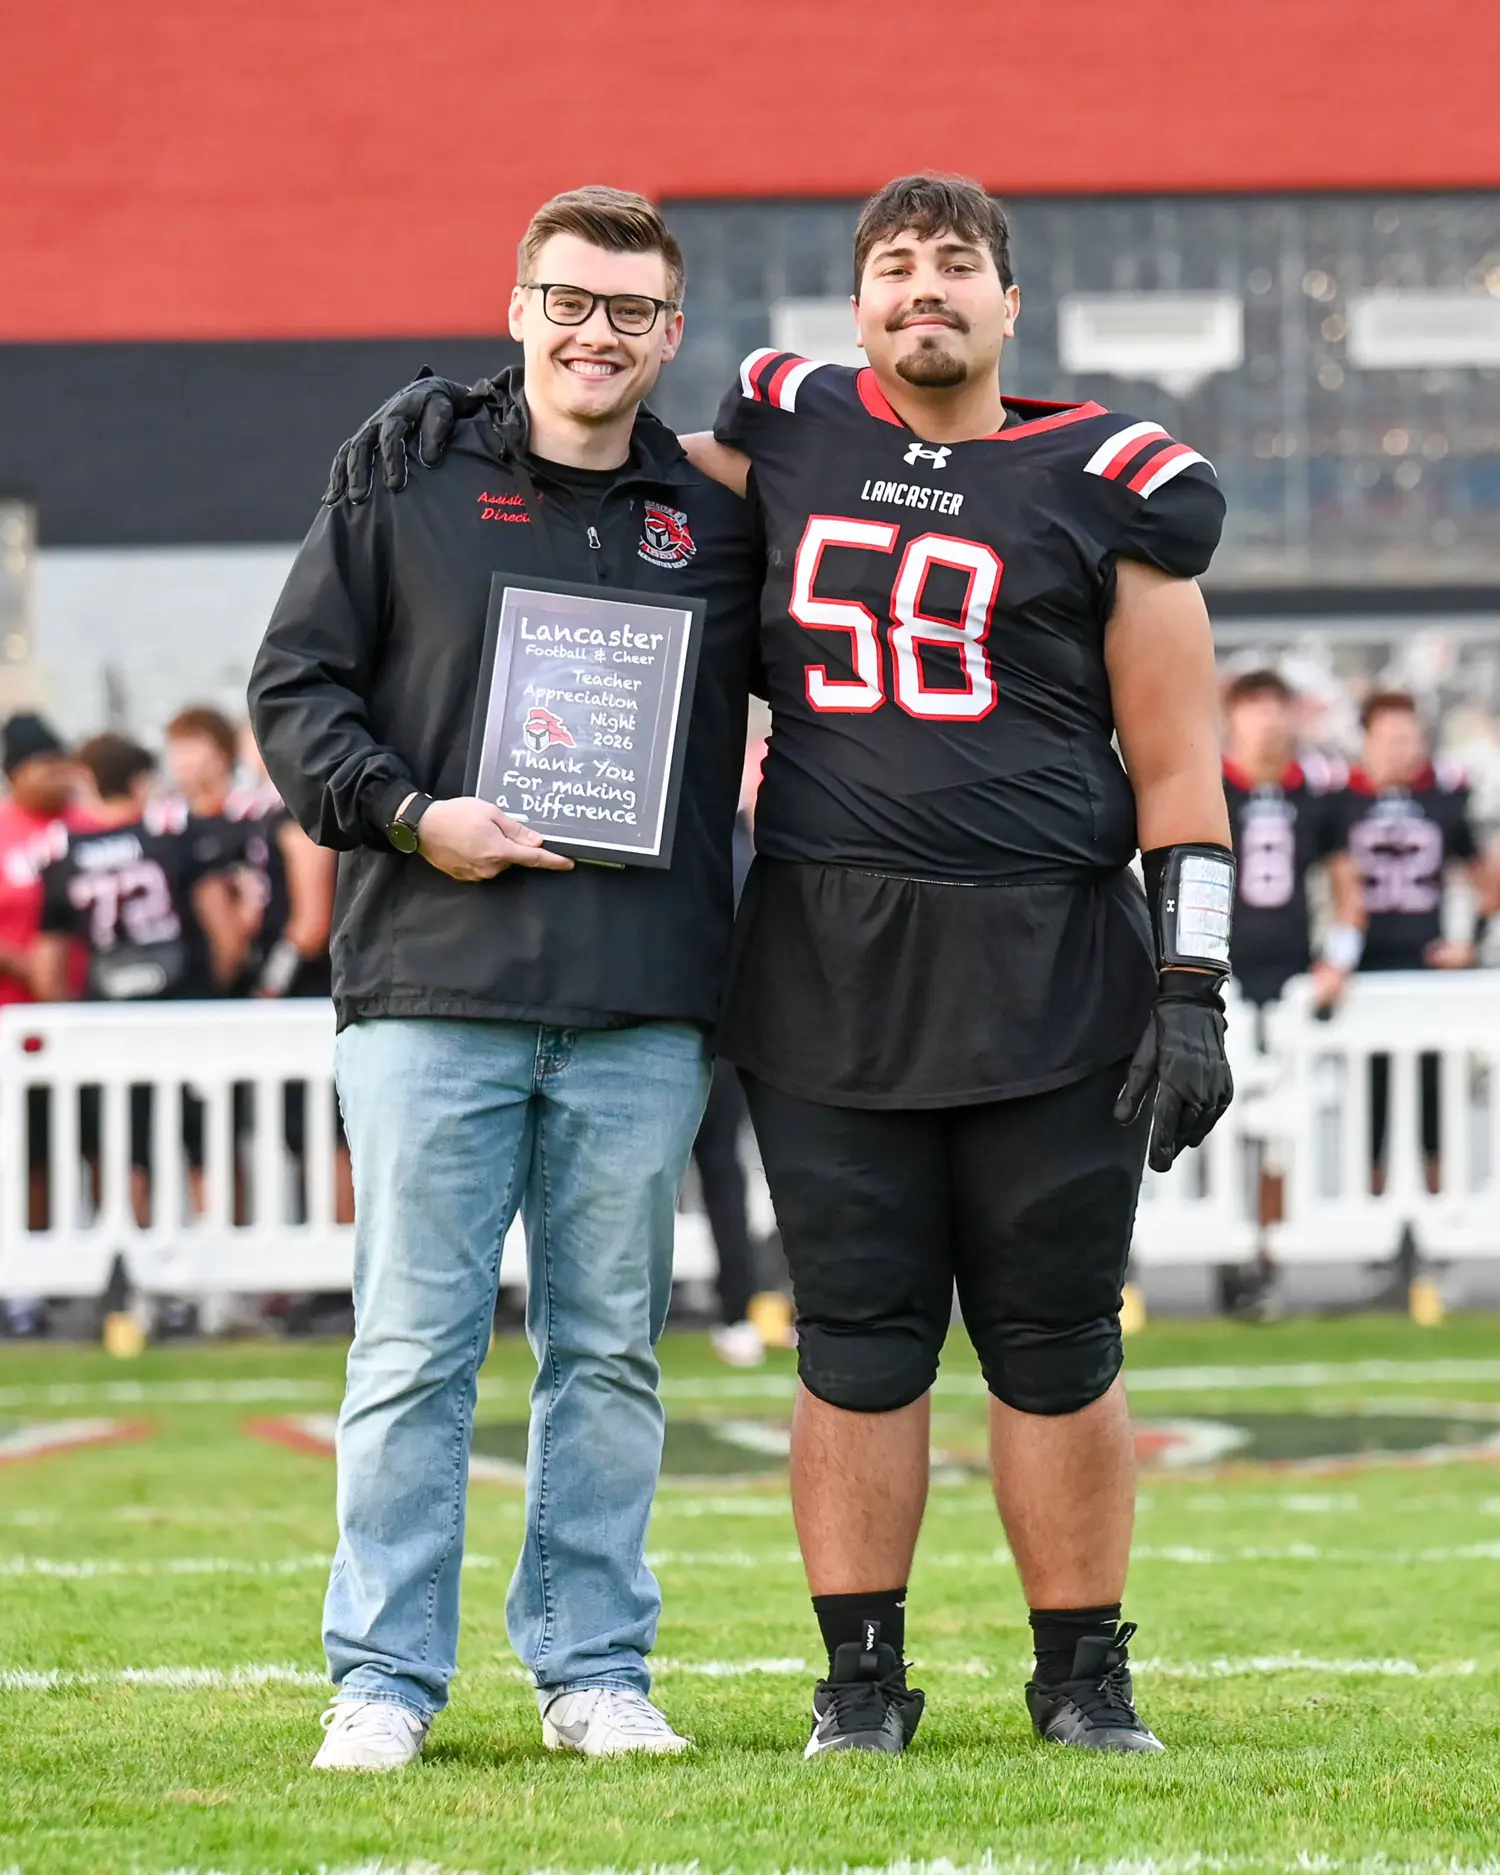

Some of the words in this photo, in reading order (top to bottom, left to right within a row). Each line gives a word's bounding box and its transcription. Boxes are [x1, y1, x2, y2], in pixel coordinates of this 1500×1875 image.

[860, 480, 964, 516] LANCASTER
[521, 616, 664, 650] Lancaster
[788, 514, 1004, 722] 58
[525, 644, 587, 661] Football
[594, 650, 606, 663] &
[612, 651, 655, 665] Cheer
[523, 683, 639, 710] Appreciation
[573, 670, 642, 692] Teacher
[590, 712, 636, 732] Night
[593, 733, 634, 750] 2026
[511, 750, 585, 774] Thank
[593, 759, 636, 783] You
[502, 770, 543, 791] For
[550, 780, 637, 809] making
[496, 795, 510, 809] a
[520, 792, 638, 825] Difference
[67, 858, 182, 952] 72
